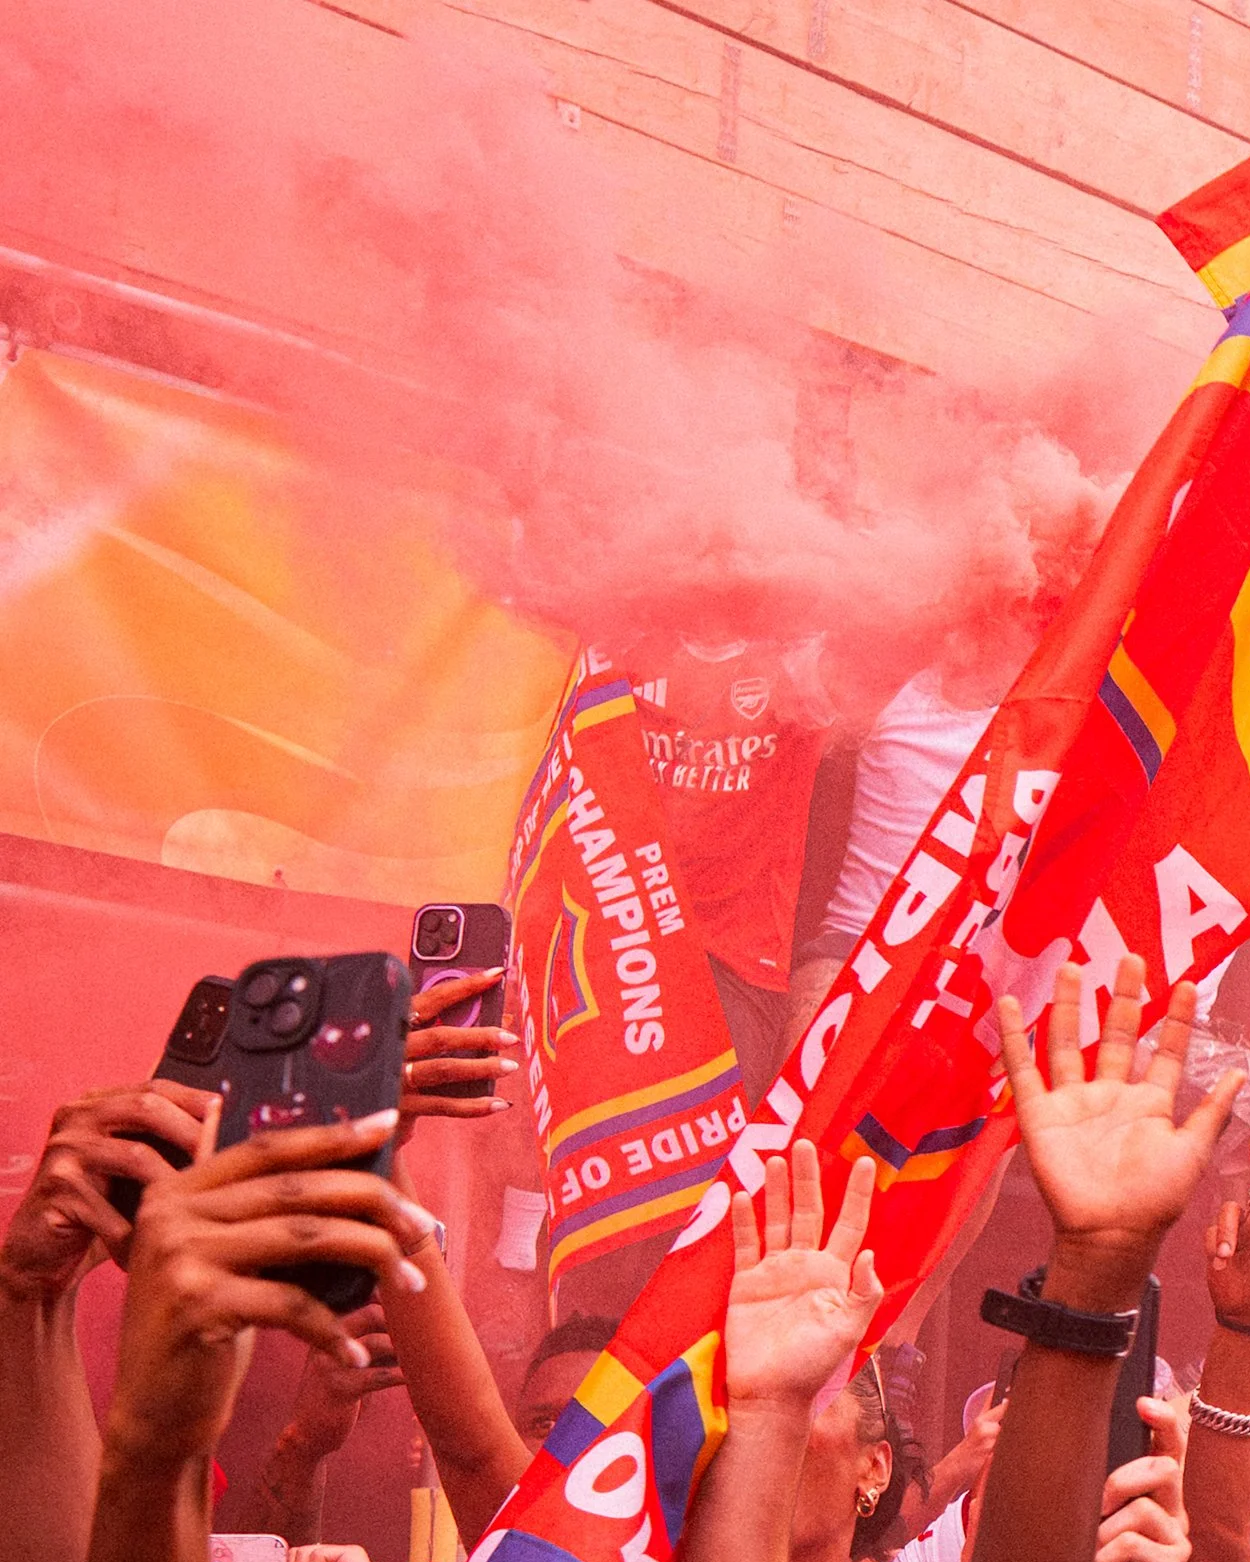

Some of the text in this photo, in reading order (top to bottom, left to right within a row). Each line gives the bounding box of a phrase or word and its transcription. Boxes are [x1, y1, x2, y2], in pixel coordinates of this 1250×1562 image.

[641, 729, 778, 767] mirates
[672, 764, 750, 792] BETTER
[567, 766, 665, 1055] CHAMPIONS
[636, 841, 685, 936] PREM
[561, 1096, 747, 1205] PRIDE OF
